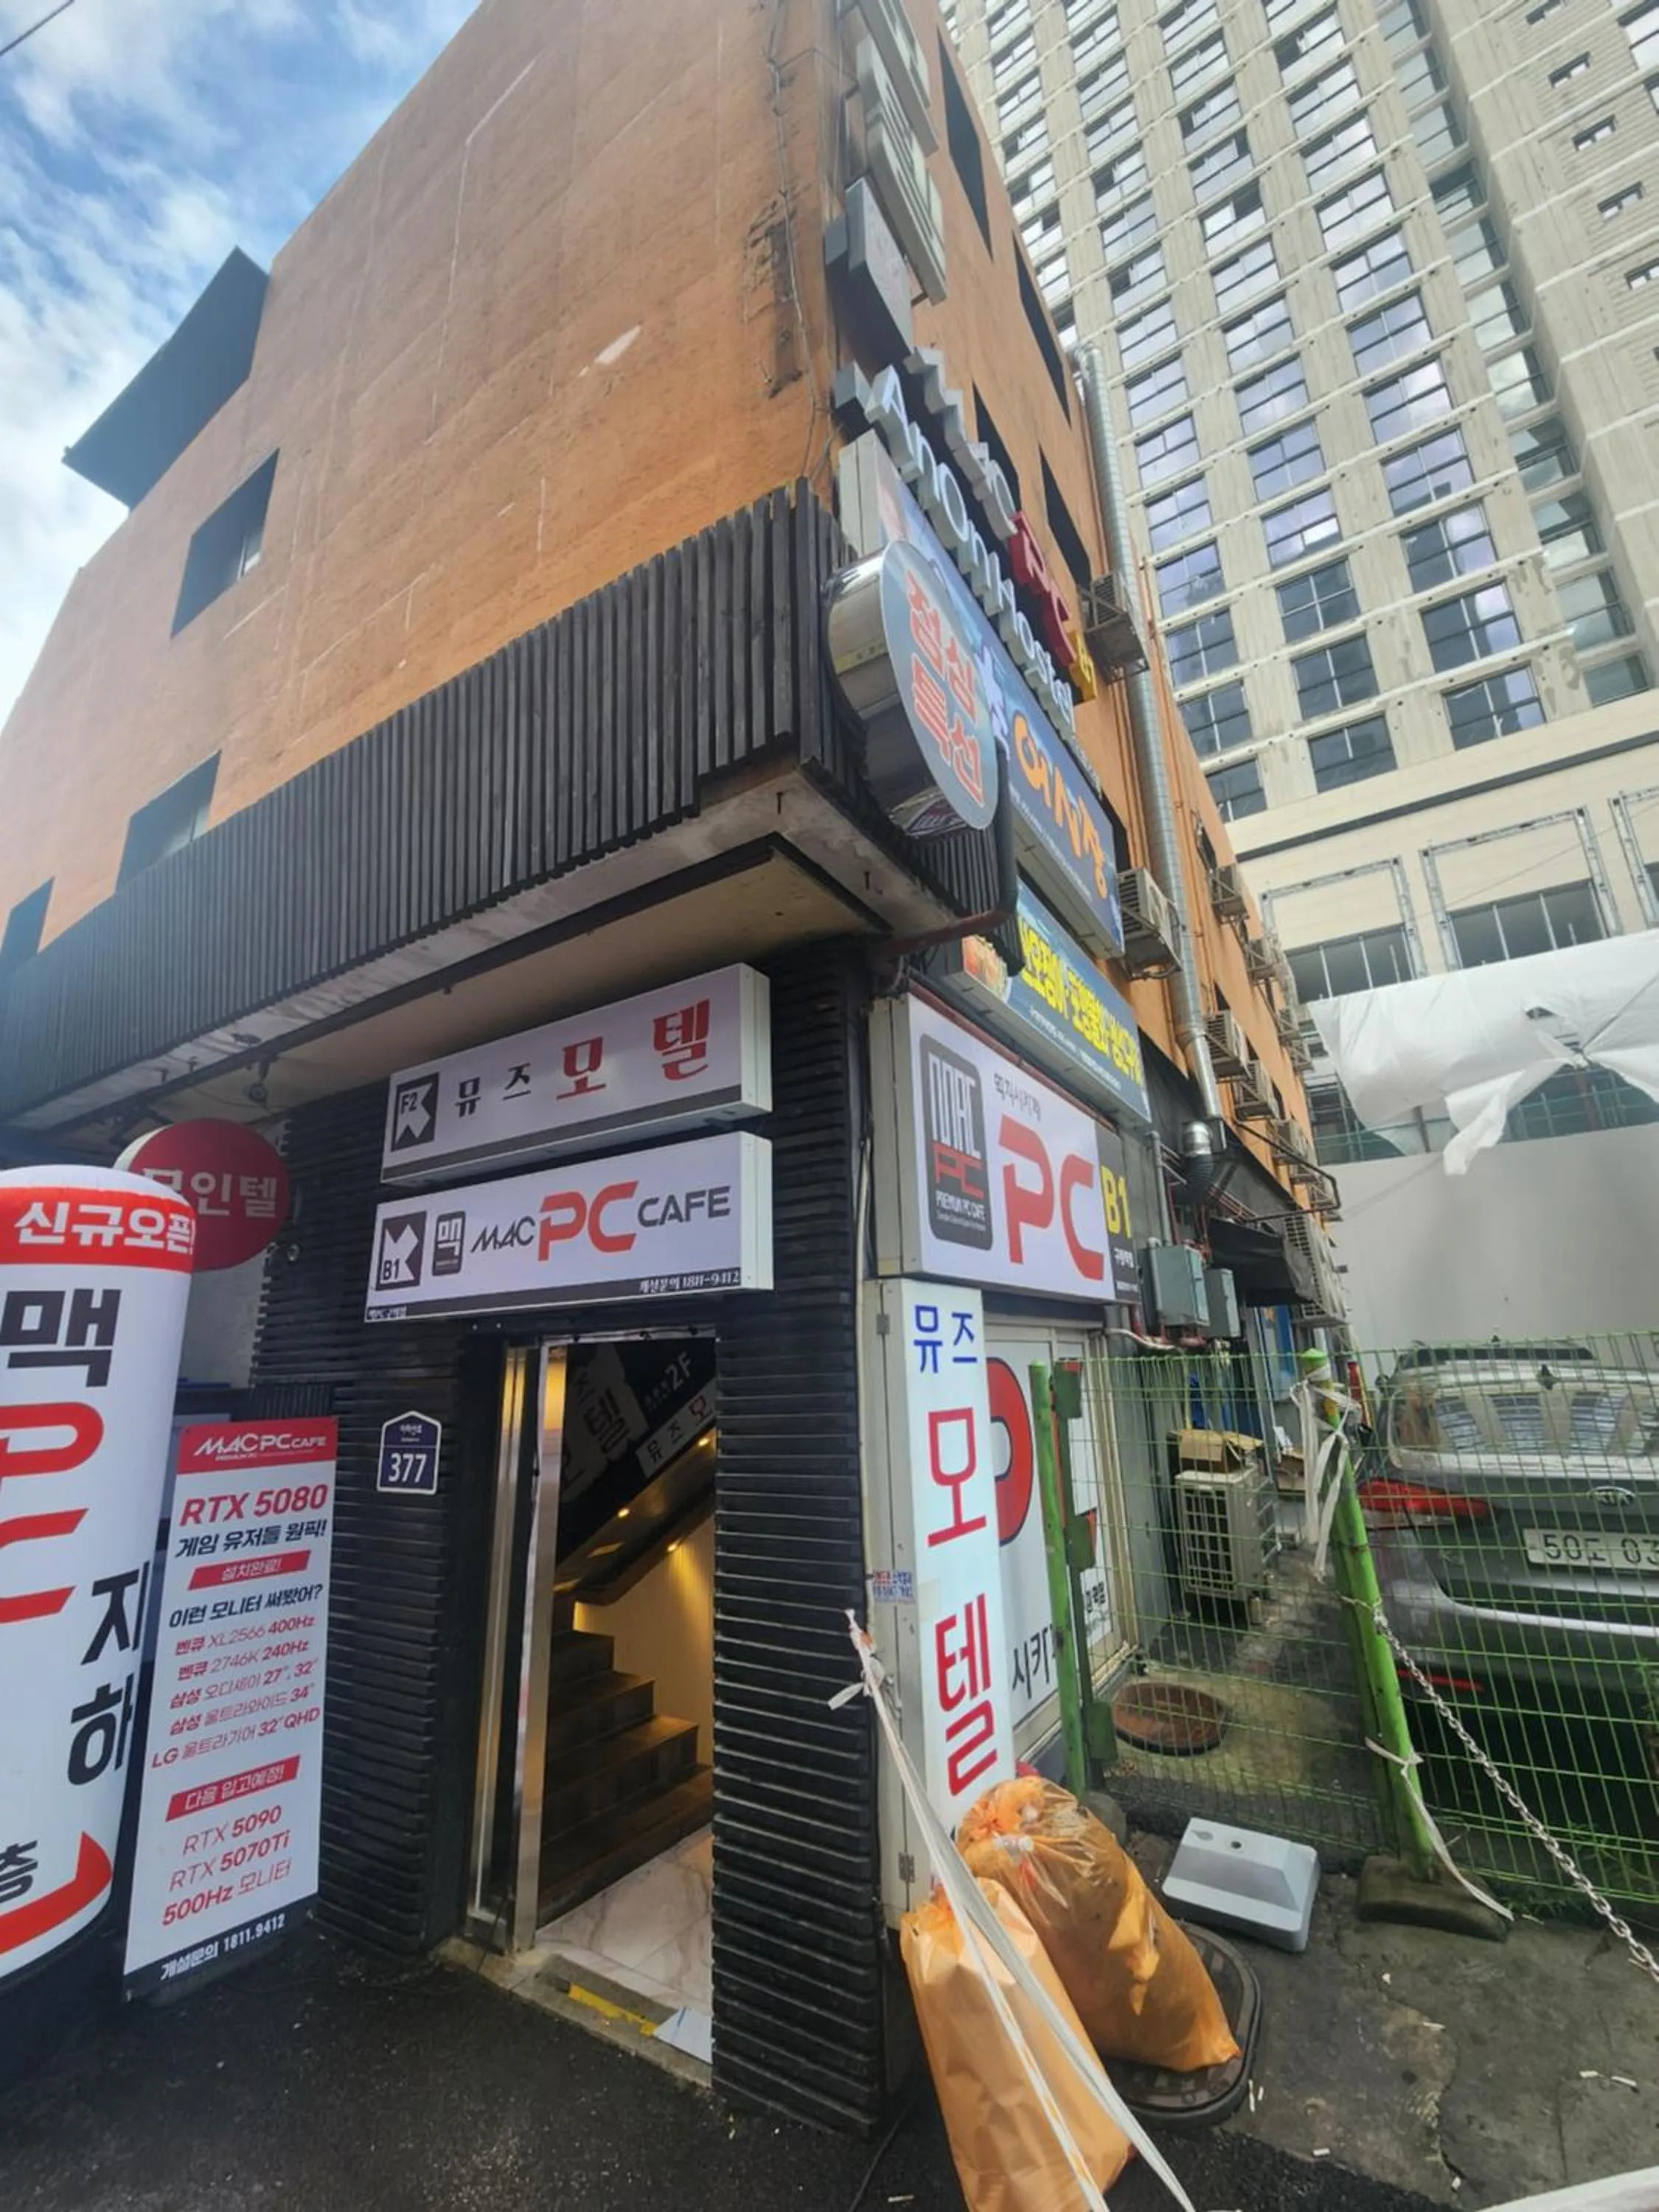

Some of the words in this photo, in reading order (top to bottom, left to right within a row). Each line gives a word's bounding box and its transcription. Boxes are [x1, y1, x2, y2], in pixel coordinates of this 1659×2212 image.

[455, 1063, 531, 1117] 뮤즈
[556, 999, 711, 1101] 모텔
[401, 1093, 418, 1116] F2
[998, 1114, 1105, 1281] PC
[1101, 1166, 1132, 1239] B1
[15, 1201, 195, 1255] 신규오픈!
[471, 1214, 537, 1253] MAC
[538, 1180, 639, 1262] PC
[638, 1186, 731, 1228] CAFE
[383, 1264, 400, 1280] B1
[0, 1289, 122, 1387] 맥
[914, 1304, 978, 1374] 뮤즈
[665, 1352, 691, 1391] 2F
[389, 1453, 427, 1483] 377
[179, 1492, 250, 1526] RTX
[254, 1484, 328, 1517] 5080
[175, 1534, 219, 1557] 게임
[223, 1526, 281, 1551] 유저들
[285, 1520, 327, 1542] 원픽!
[169, 1605, 206, 1627] 이런
[209, 1595, 262, 1620] 모니터
[927, 1406, 999, 1798] 모텔
[175, 1636, 205, 1655] 벤큐
[268, 1616, 315, 1633] 400Hz
[262, 1640, 309, 1660] 240Hz
[68, 1561, 150, 1786] 지하
[170, 1688, 202, 1709] 삼성
[170, 1714, 202, 1736] 삼성
[152, 1747, 179, 1768] LG
[185, 1790, 218, 1810] 다음
[183, 1820, 229, 1856] RTX
[232, 1805, 282, 1838] 5090
[169, 1857, 217, 1892] RTX
[220, 1829, 291, 1872] 5070Ti
[162, 1885, 234, 1927] 500Hz
[237, 1858, 293, 1896] 모니터
[223, 1913, 285, 1952] 1811.9412
